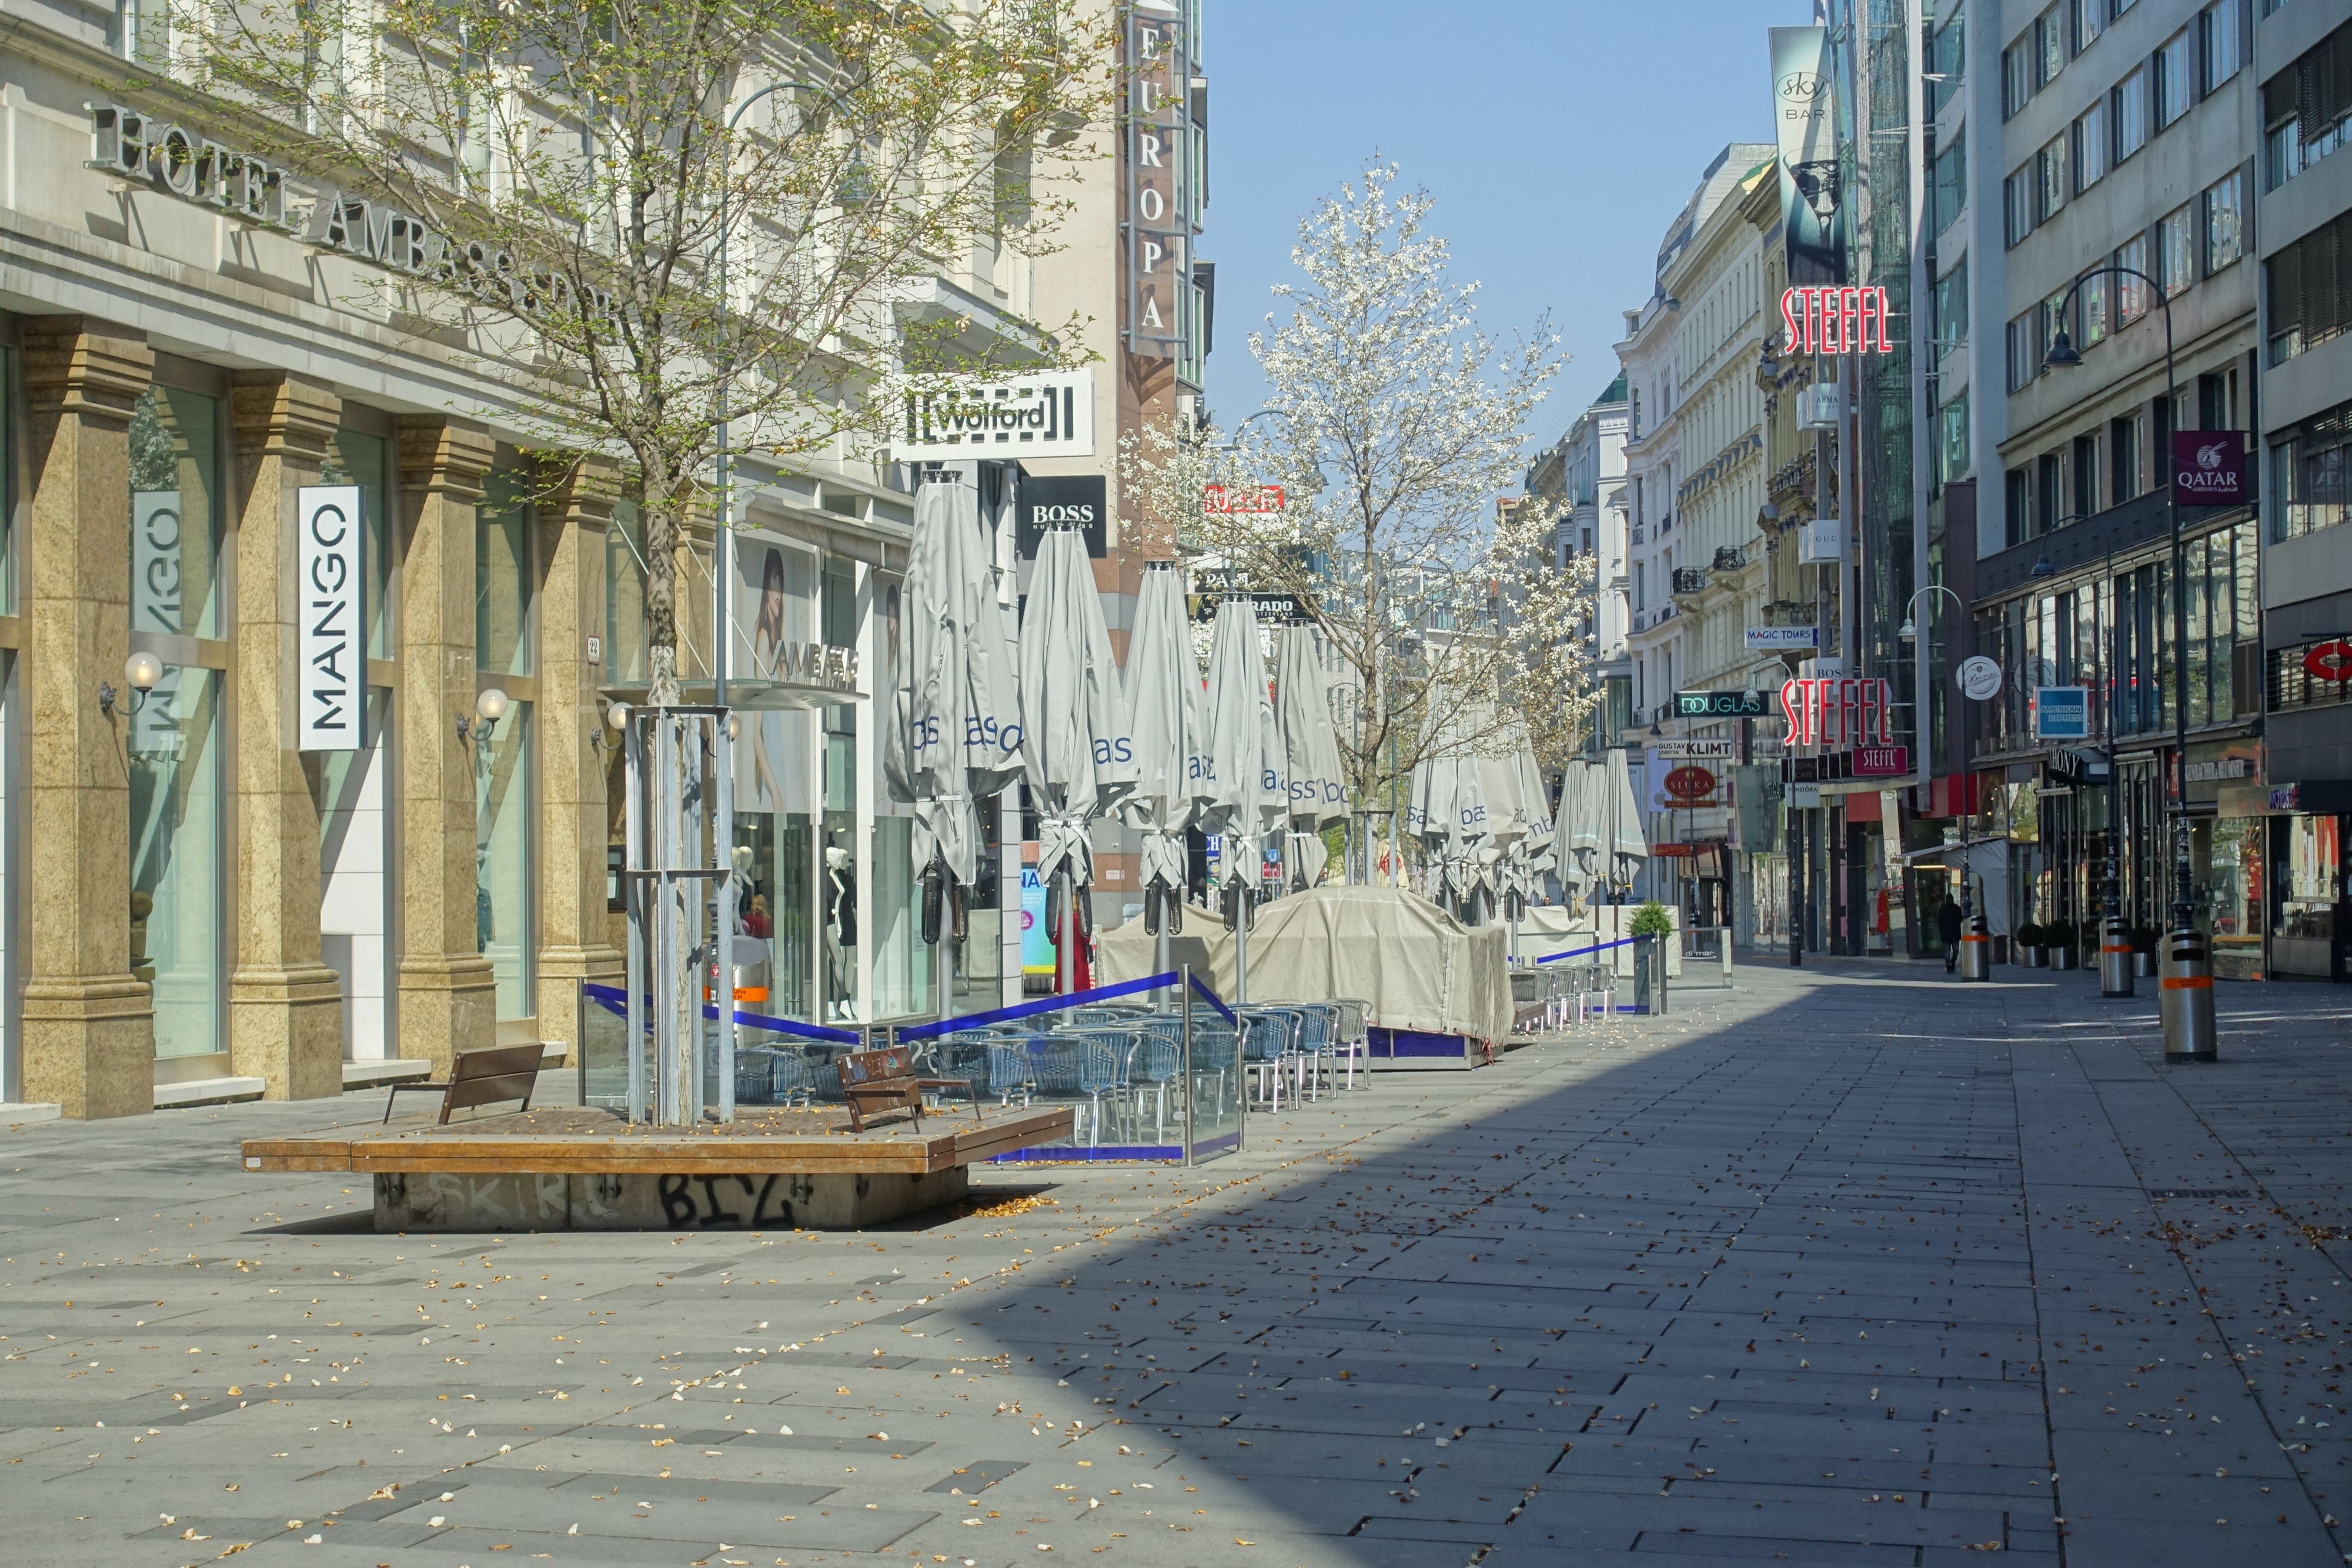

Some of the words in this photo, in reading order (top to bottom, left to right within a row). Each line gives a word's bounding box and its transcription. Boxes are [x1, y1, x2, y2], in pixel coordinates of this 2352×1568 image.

[1783, 72, 1825, 102] sky
[1786, 109, 1825, 119] BAR
[83, 100, 309, 236] HOTEL
[1139, 26, 1164, 328] EUROPA
[1780, 285, 1893, 355] STEFFL
[938, 400, 1045, 431] Wolford
[2178, 472, 2237, 489] QATAR
[1032, 504, 1094, 523] BOSS
[1251, 601, 1294, 612] RADO
[311, 503, 347, 730] MANGO
[1747, 630, 1778, 640] MAGIC
[1781, 630, 1811, 640] TOURS
[589, 639, 598, 654] 22
[1681, 697, 1761, 714] DOUGLAS
[1780, 678, 1893, 746] STEFFL
[2040, 705, 2082, 714] AMERICAN
[2048, 714, 2084, 722] EXPRESS
[1686, 742, 1731, 754] KLIMT
[1863, 749, 1896, 767] STEFFL
[1670, 780, 1710, 790] SLUKA
